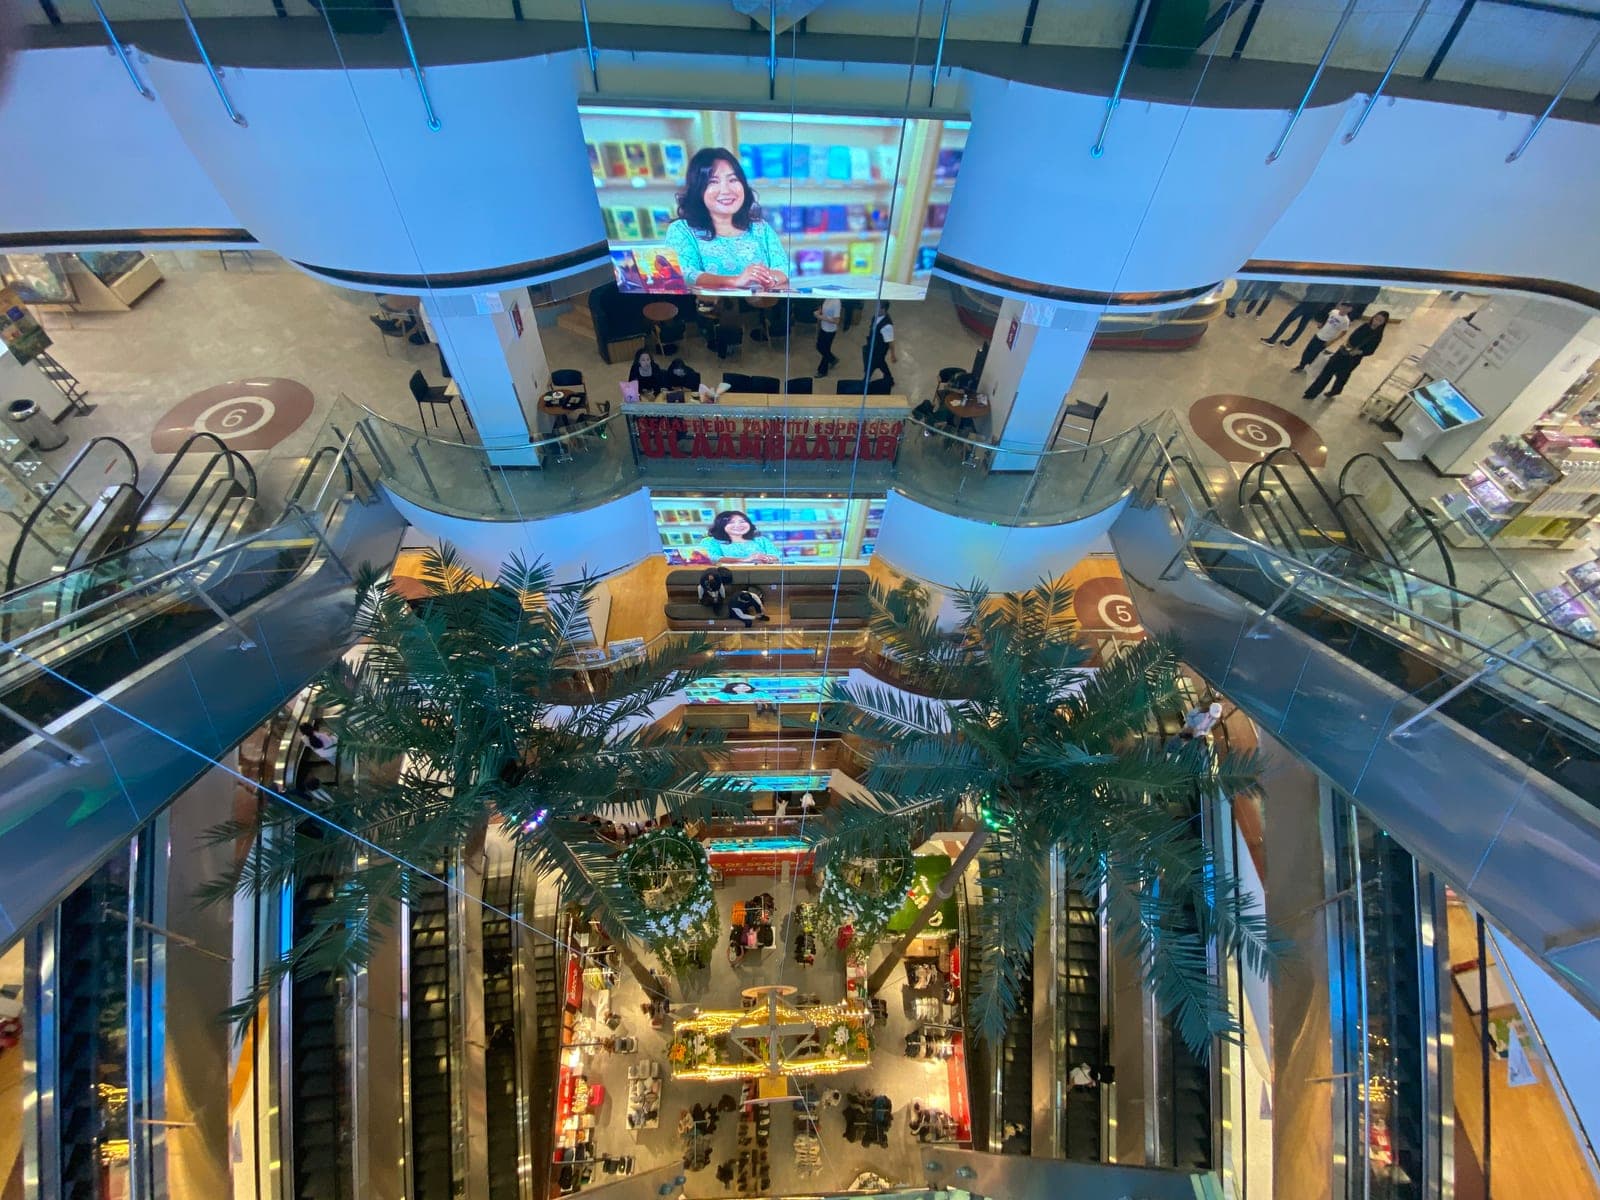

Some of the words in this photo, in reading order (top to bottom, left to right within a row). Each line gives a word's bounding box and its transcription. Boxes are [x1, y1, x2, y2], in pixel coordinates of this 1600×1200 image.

[221, 408, 247, 427] 6
[637, 416, 737, 433] SEGAFREDO
[743, 416, 809, 434] ZANETTI
[1246, 423, 1268, 442] 6
[638, 430, 898, 461] ULAANBAATAR
[1115, 605, 1132, 622] 5
